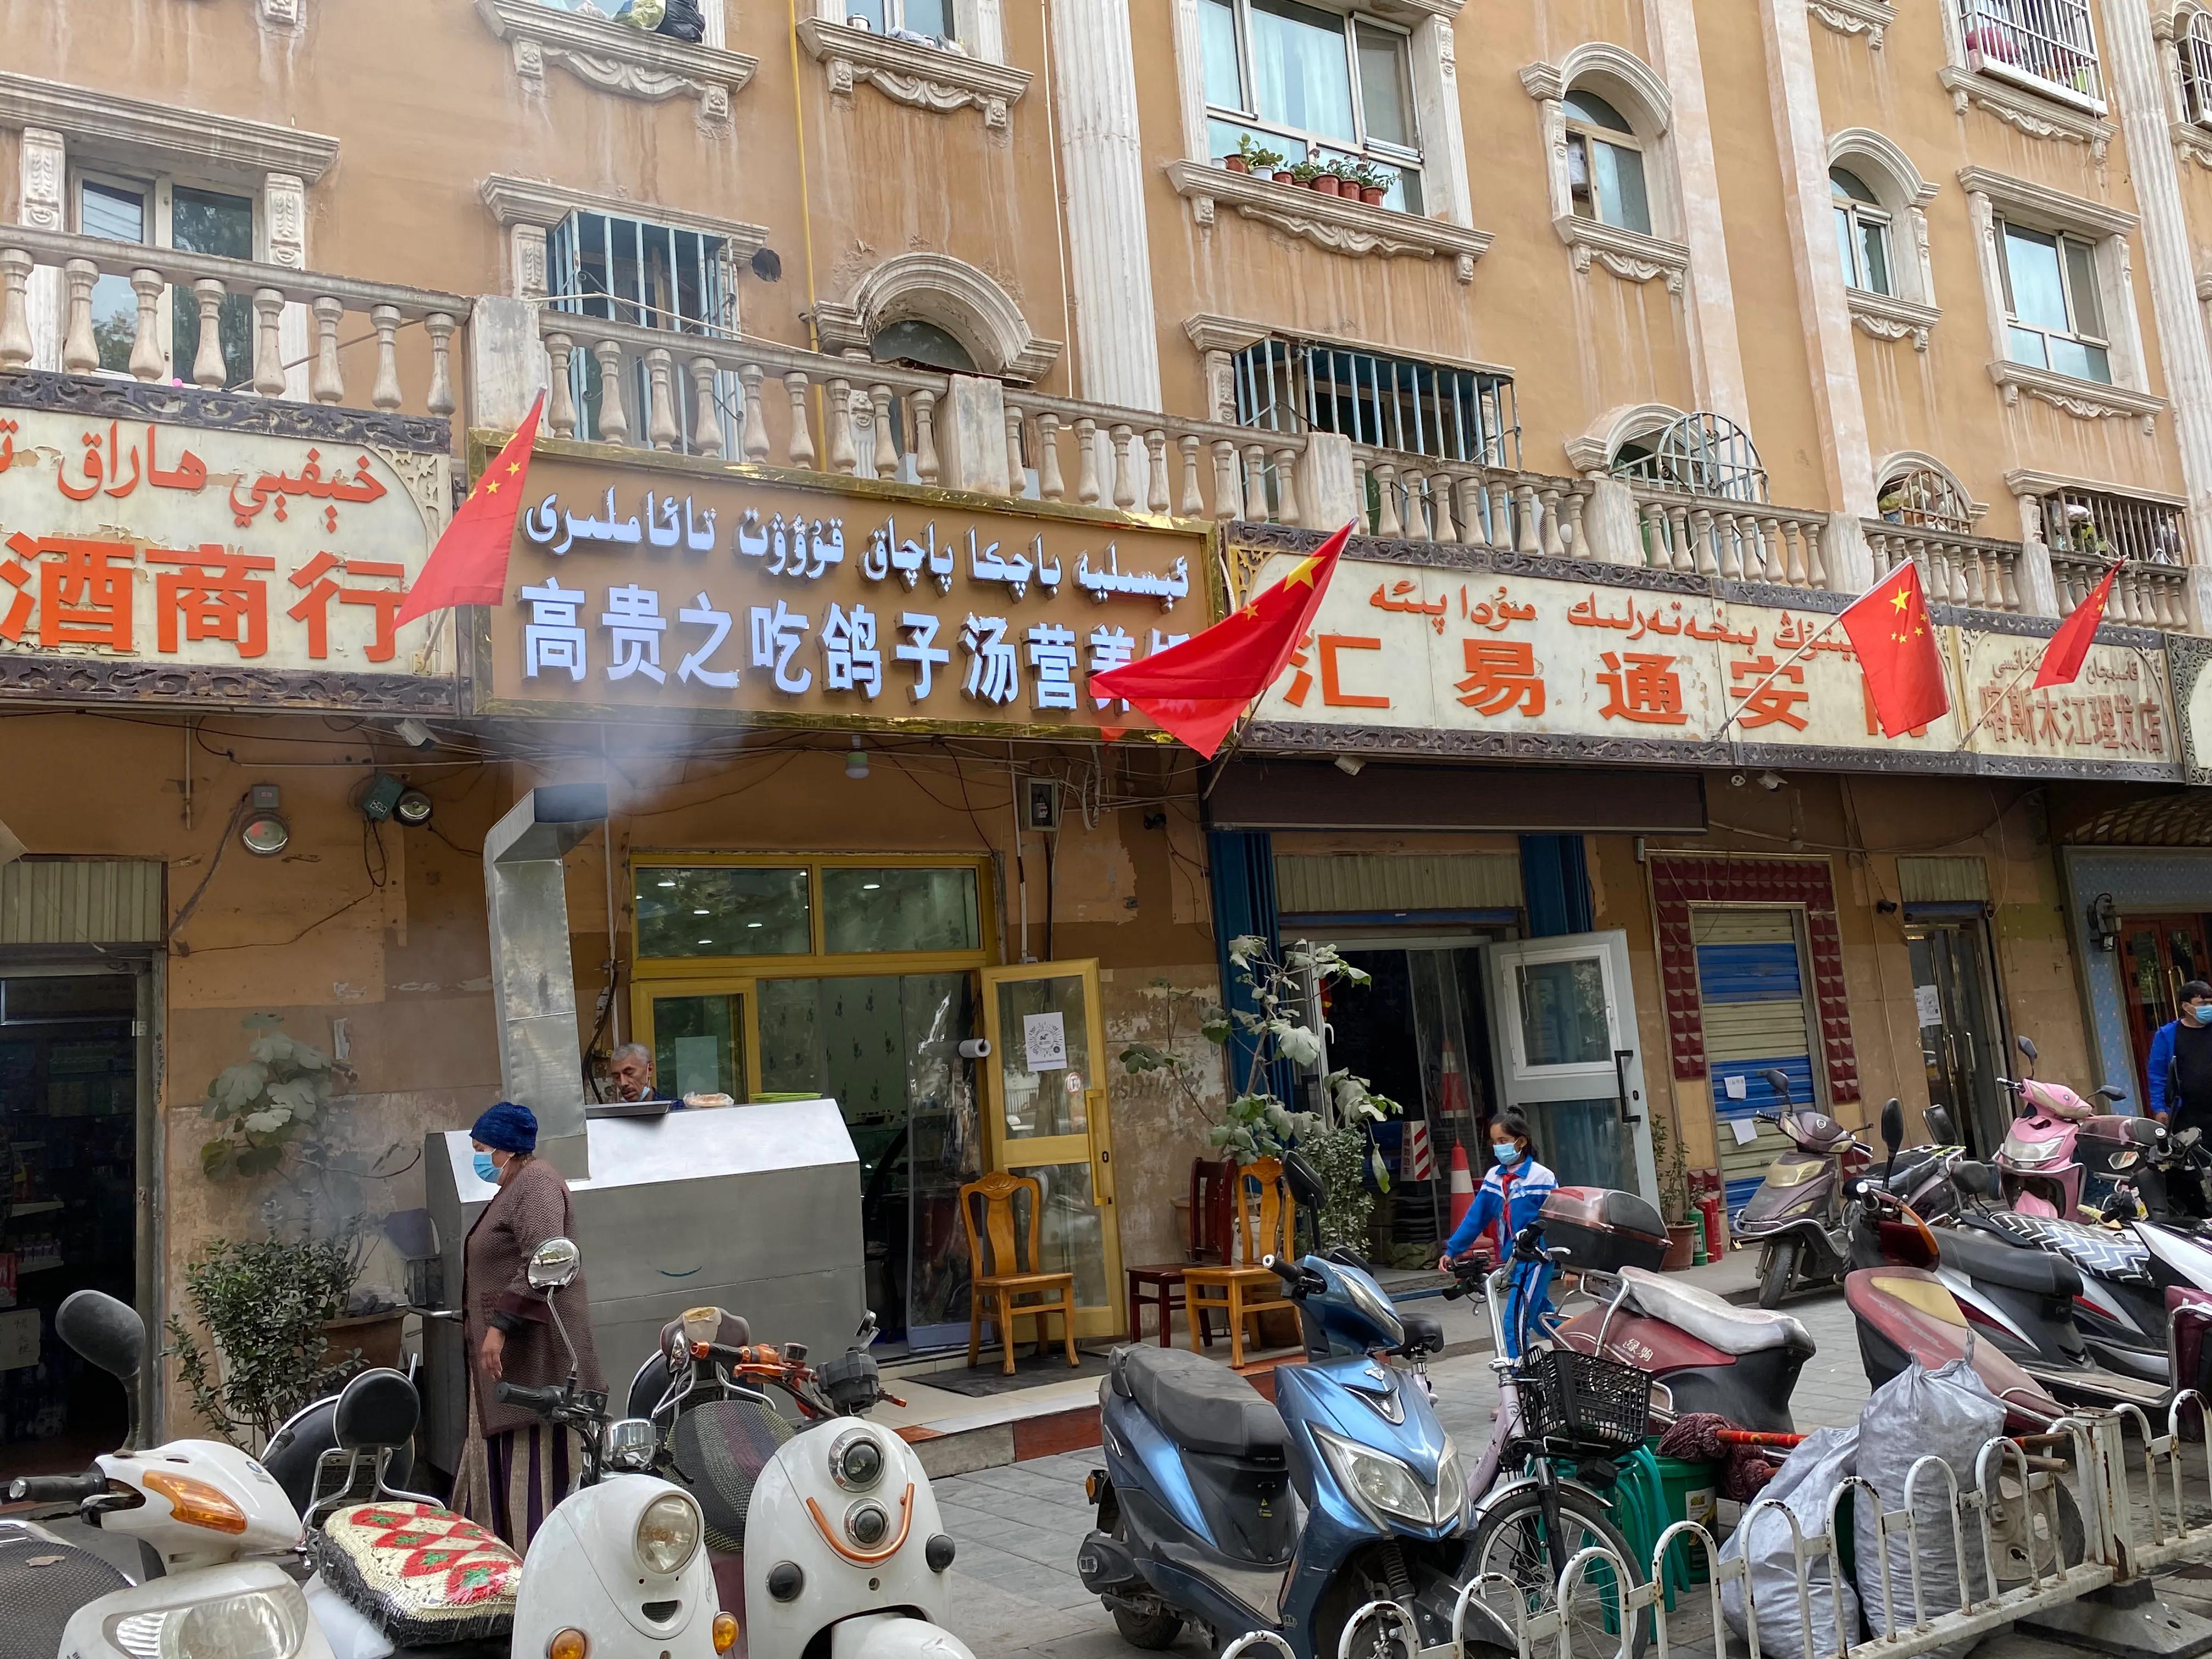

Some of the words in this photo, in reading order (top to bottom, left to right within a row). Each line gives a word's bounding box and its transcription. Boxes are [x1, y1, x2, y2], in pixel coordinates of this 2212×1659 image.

[57, 420, 208, 500] ھاراق
[0, 531, 409, 662] 酒商行
[861, 516, 955, 593] پاچاق
[521, 576, 1192, 712] 高贵之吃鸽子汤营养
[1283, 634, 1927, 737] 汇易通安
[1978, 680, 2163, 753] 喀斯木江理发店
